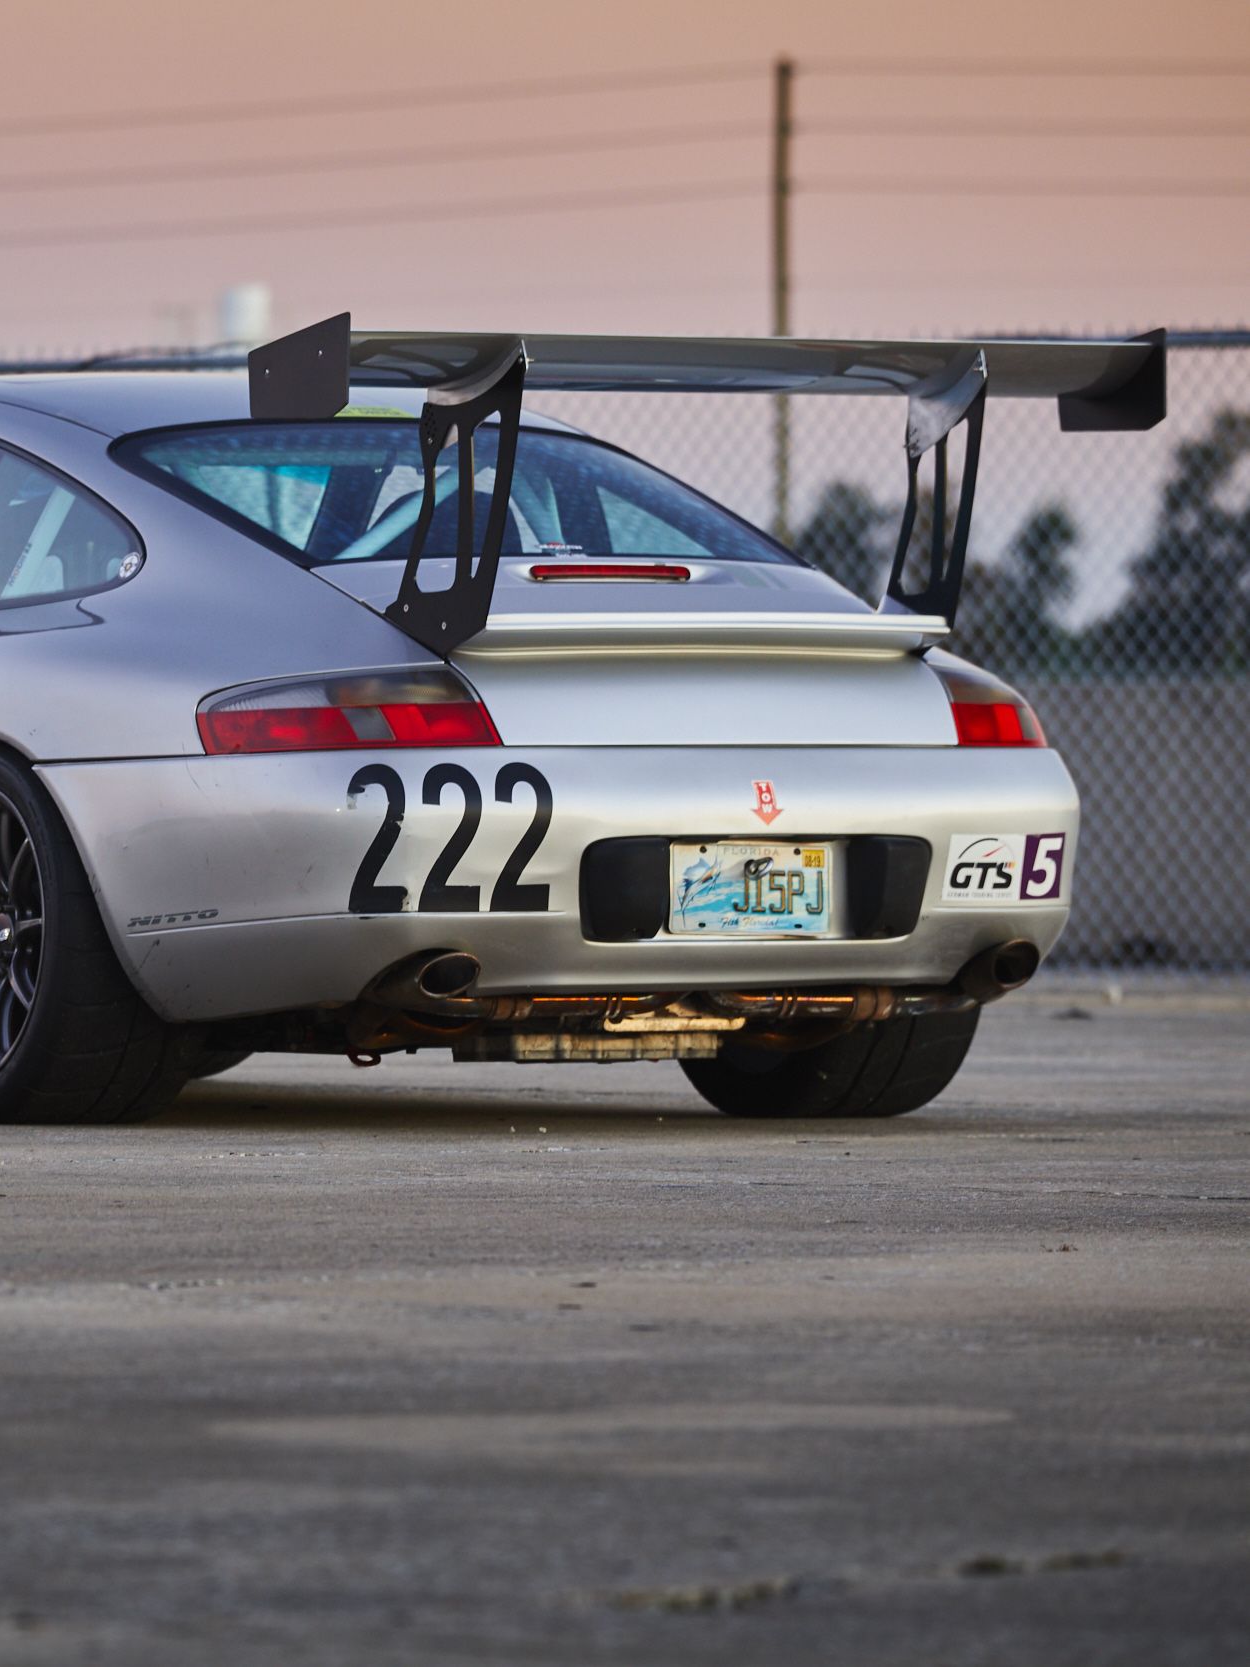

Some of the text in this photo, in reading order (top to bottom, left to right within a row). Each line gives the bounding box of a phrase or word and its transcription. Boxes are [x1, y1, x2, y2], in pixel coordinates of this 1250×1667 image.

[758, 782, 773, 814] TOW
[347, 763, 553, 912] 222
[723, 846, 781, 857] FLORIDA
[950, 836, 1063, 897] GTS 5
[127, 908, 220, 928] NITTO
